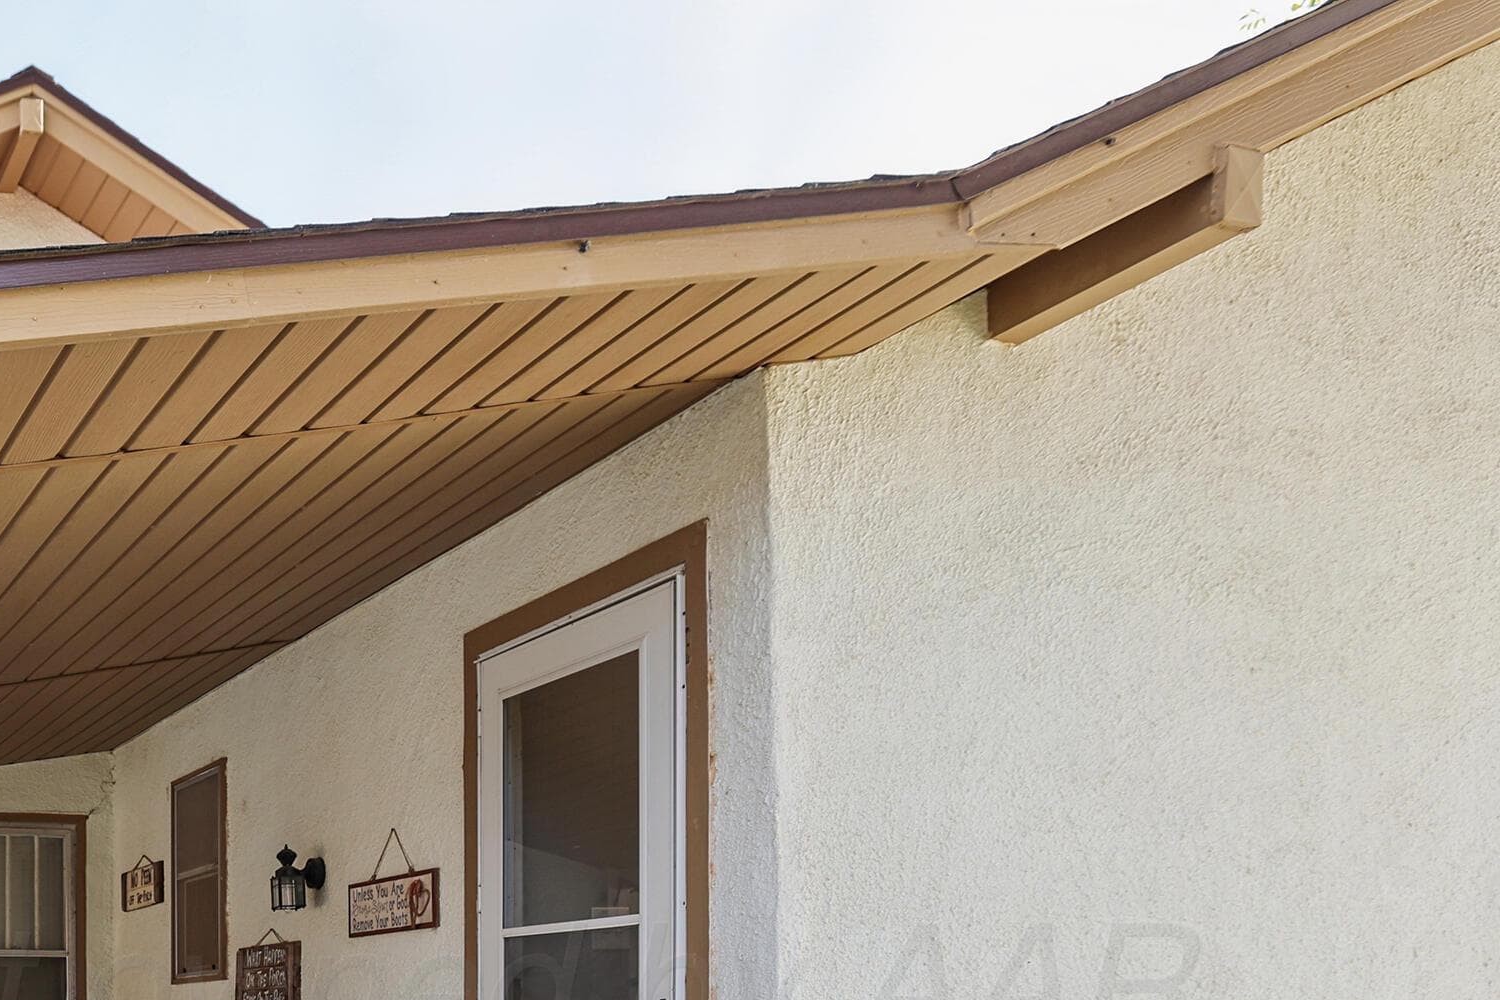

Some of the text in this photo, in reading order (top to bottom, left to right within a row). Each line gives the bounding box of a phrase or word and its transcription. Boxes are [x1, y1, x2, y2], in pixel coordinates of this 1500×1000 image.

[352, 882, 405, 902] Unless You Are
[389, 900, 396, 911] or
[352, 911, 409, 932] Remove Your Boots
